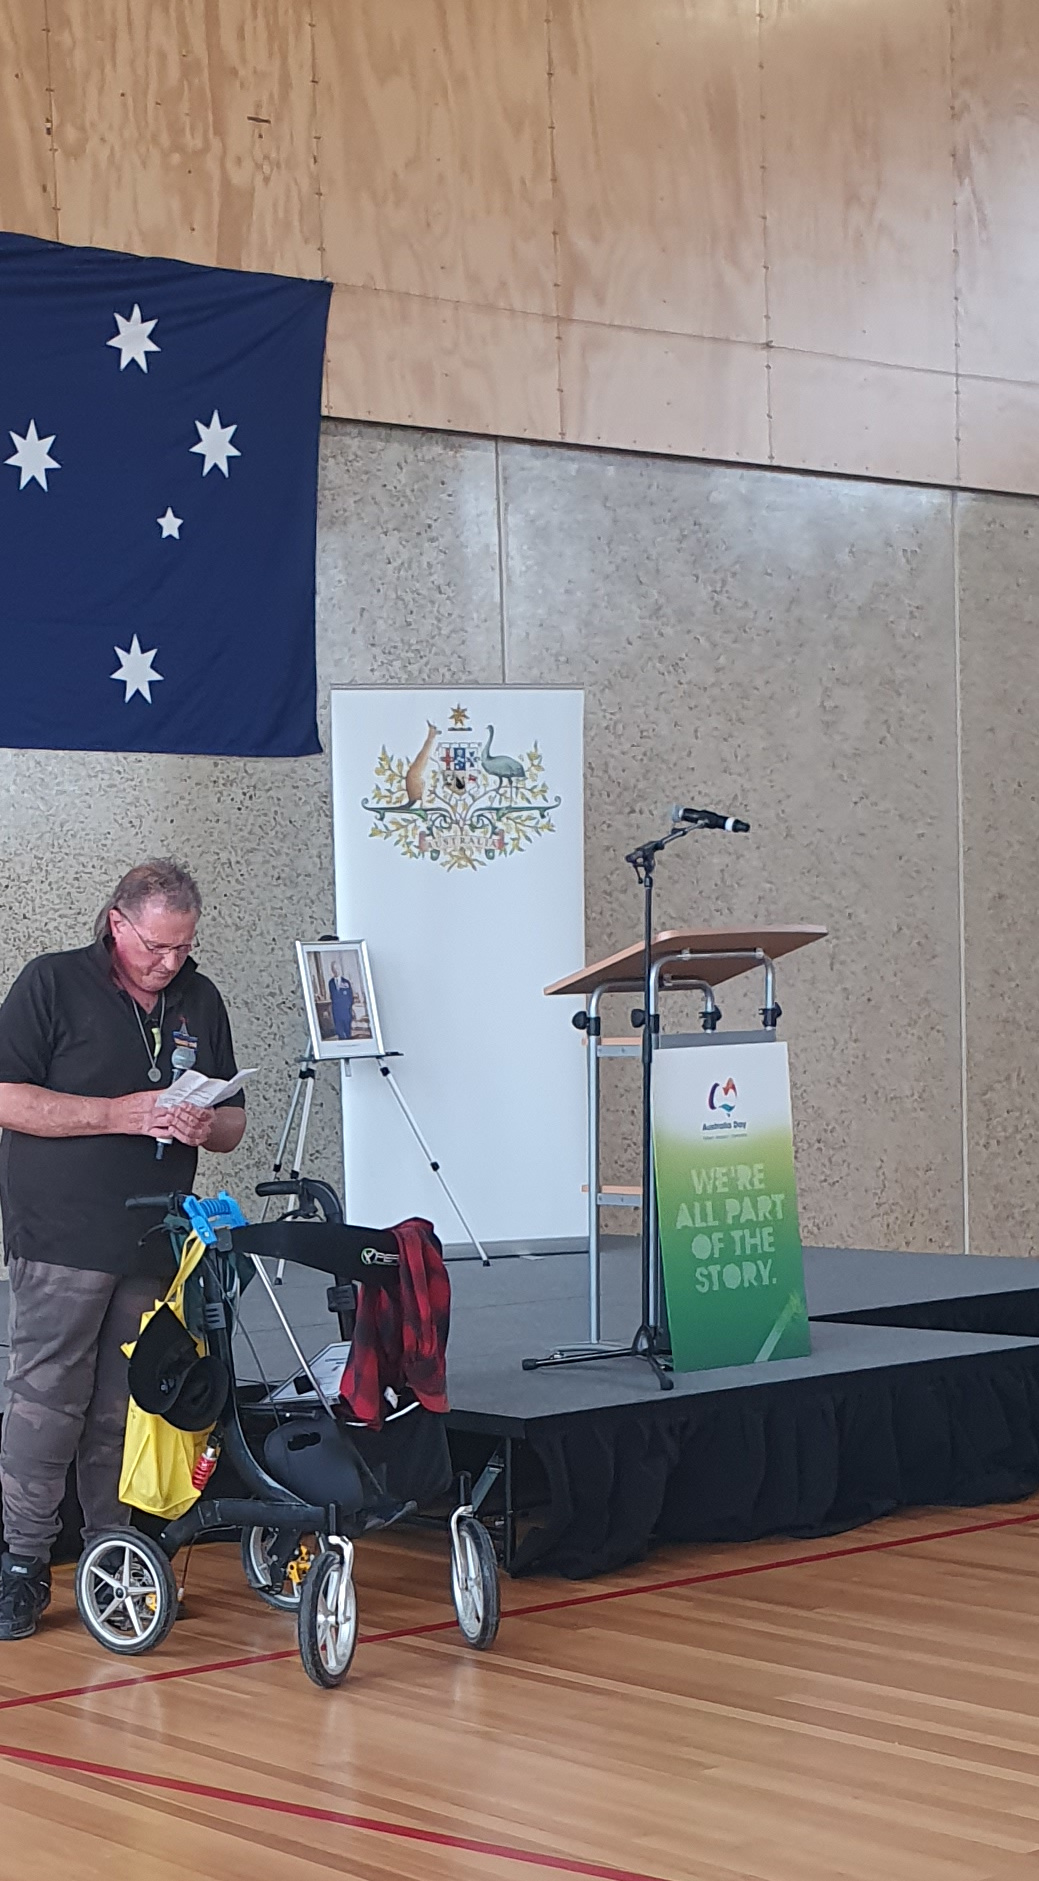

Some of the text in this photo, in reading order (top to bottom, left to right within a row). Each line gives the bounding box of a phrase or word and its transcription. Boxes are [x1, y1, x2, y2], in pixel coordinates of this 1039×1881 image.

[691, 1163, 766, 1195] WE'RE
[676, 1193, 786, 1230] ALL PART
[691, 1226, 776, 1260] OF THE
[695, 1259, 778, 1293] STORY.
